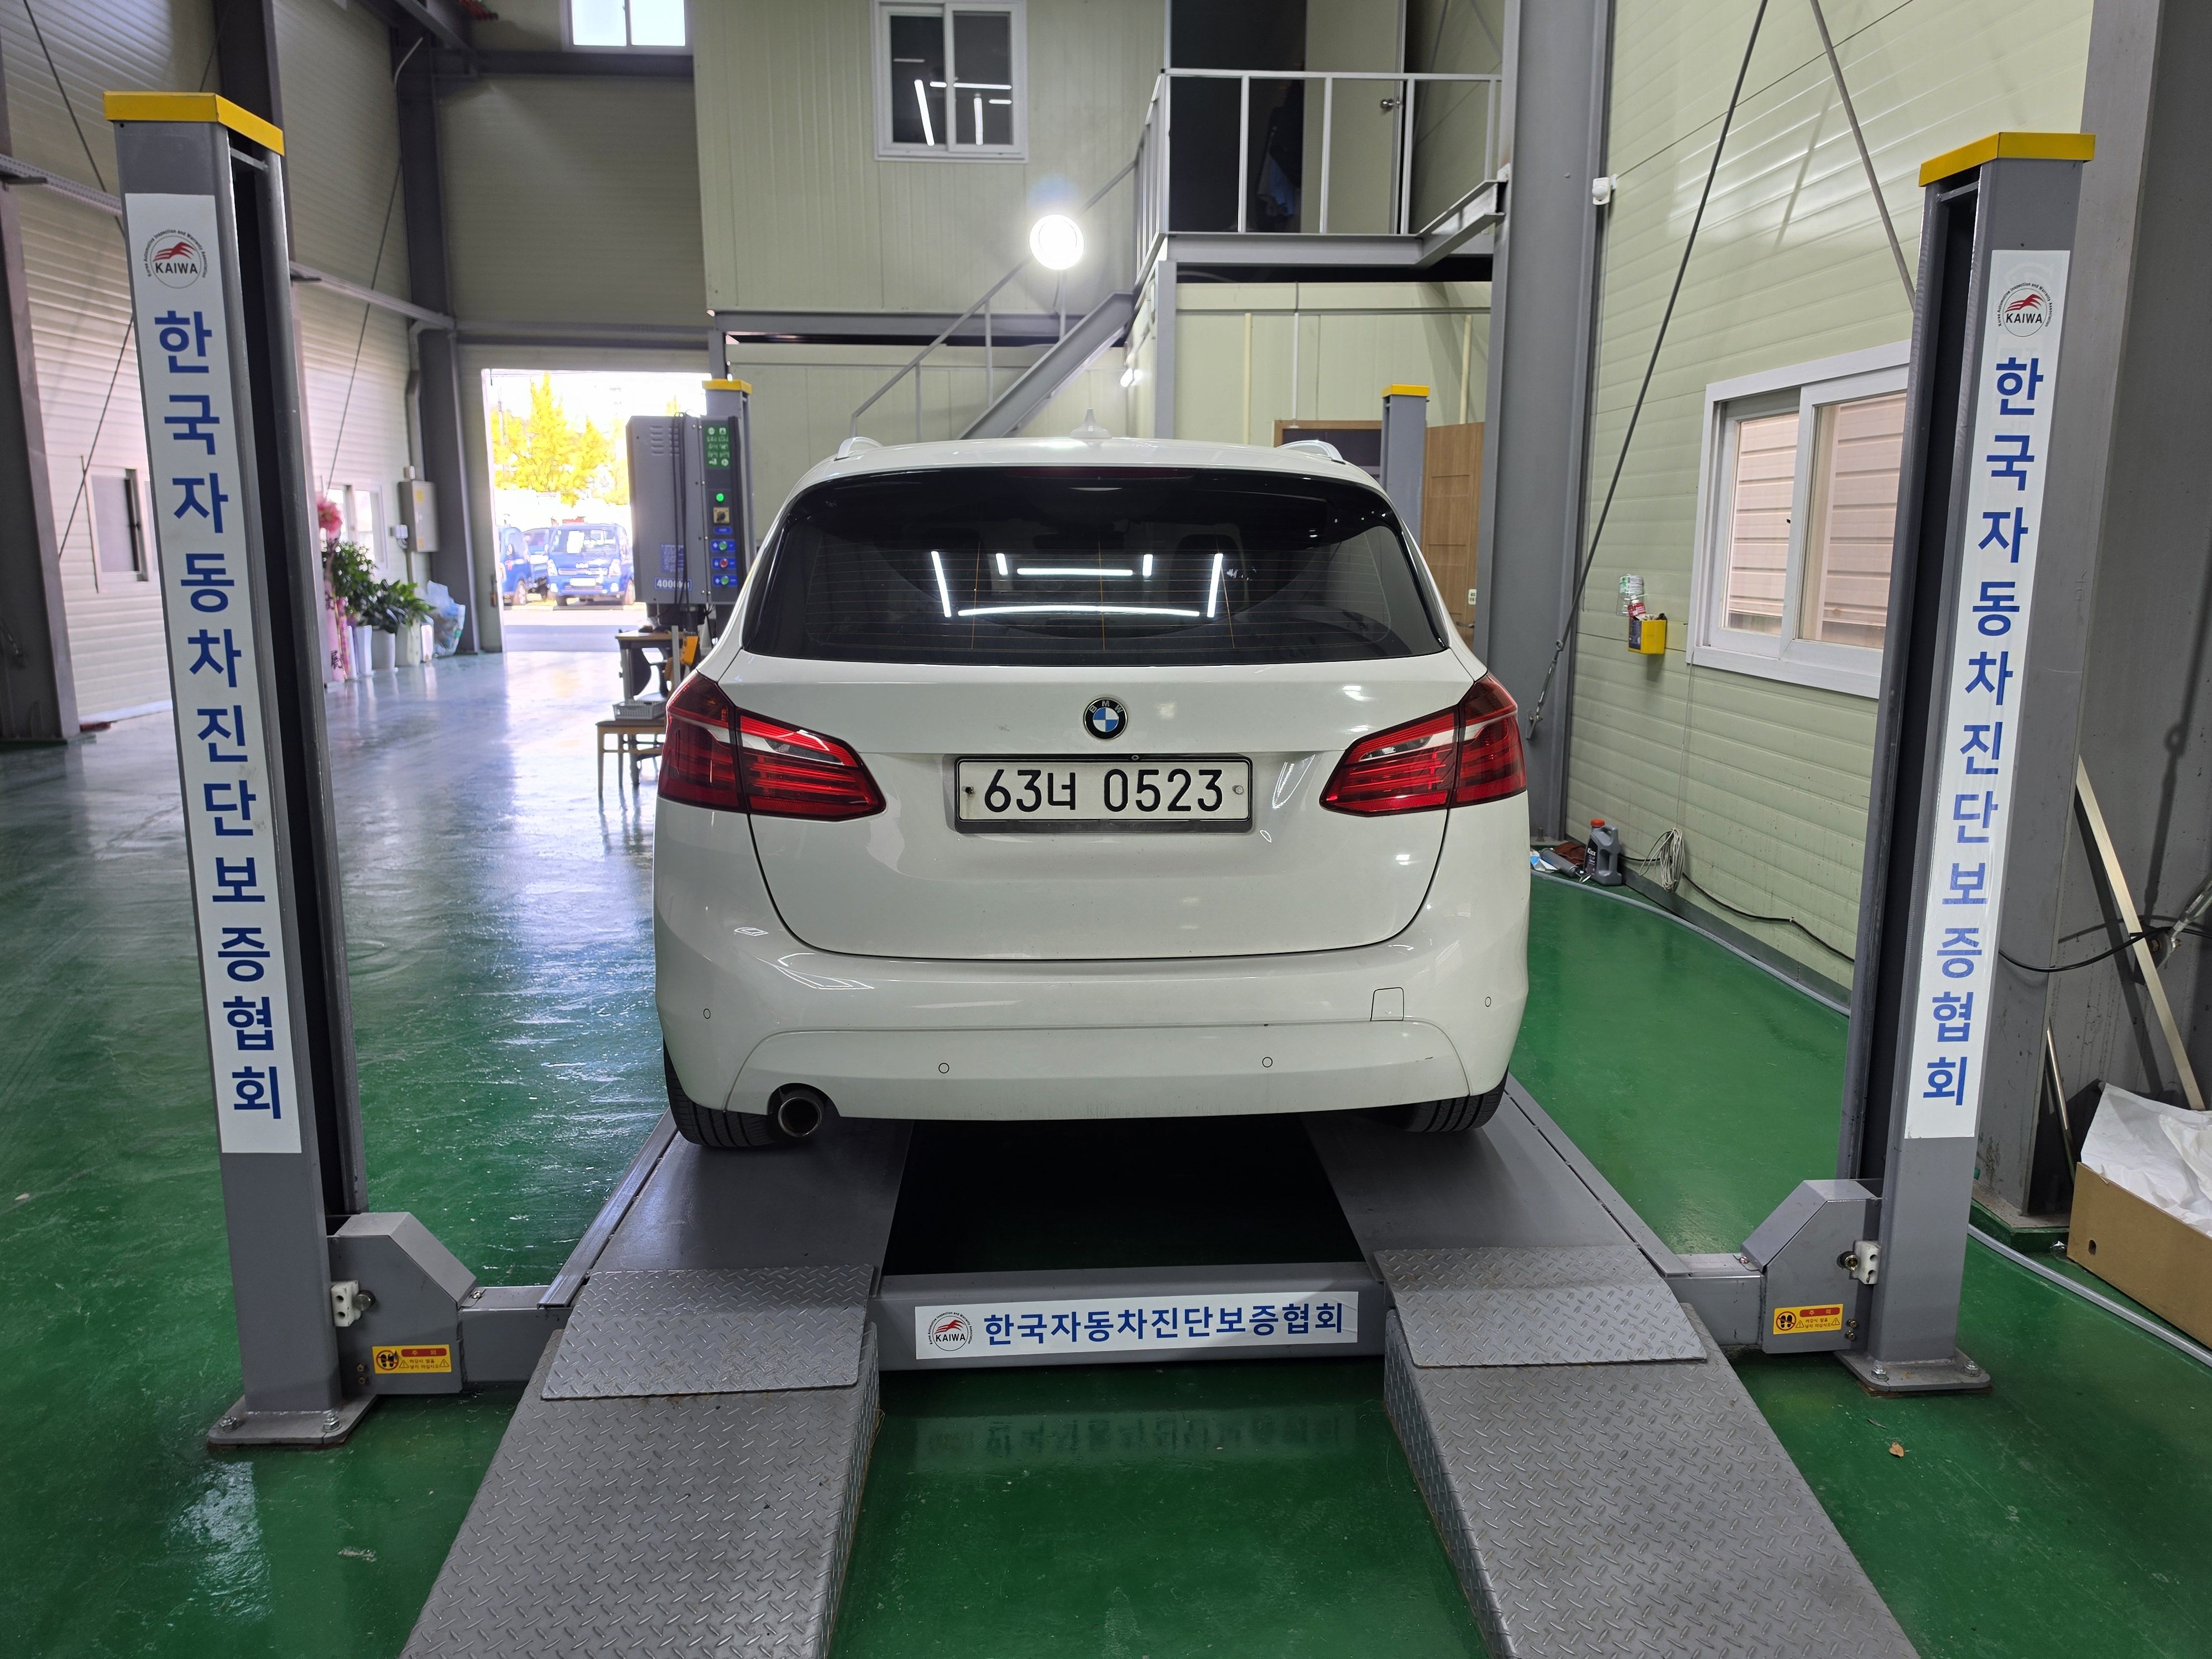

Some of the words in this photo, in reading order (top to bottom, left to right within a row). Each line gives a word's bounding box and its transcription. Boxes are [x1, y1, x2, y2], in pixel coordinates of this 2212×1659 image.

[154, 229, 176, 238] Inspection
[187, 233, 203, 251] Warranty
[155, 262, 199, 274] KAIWA
[2010, 282, 2031, 291] Inspection
[2039, 286, 2051, 301] Warranty
[2006, 313, 2042, 324] KAIWA
[2044, 302, 2053, 327] Association
[154, 310, 281, 1119] 한국자동차진단보증협회
[1089, 700, 1124, 714] BMW
[1923, 357, 2044, 1106] 한국자동차진단보증협회
[984, 769, 1076, 813] 63너
[1104, 769, 1223, 812] 0523
[984, 1303, 1343, 1346] 한국자동차진단보증협회
[936, 1333, 966, 1342] KAIWA
